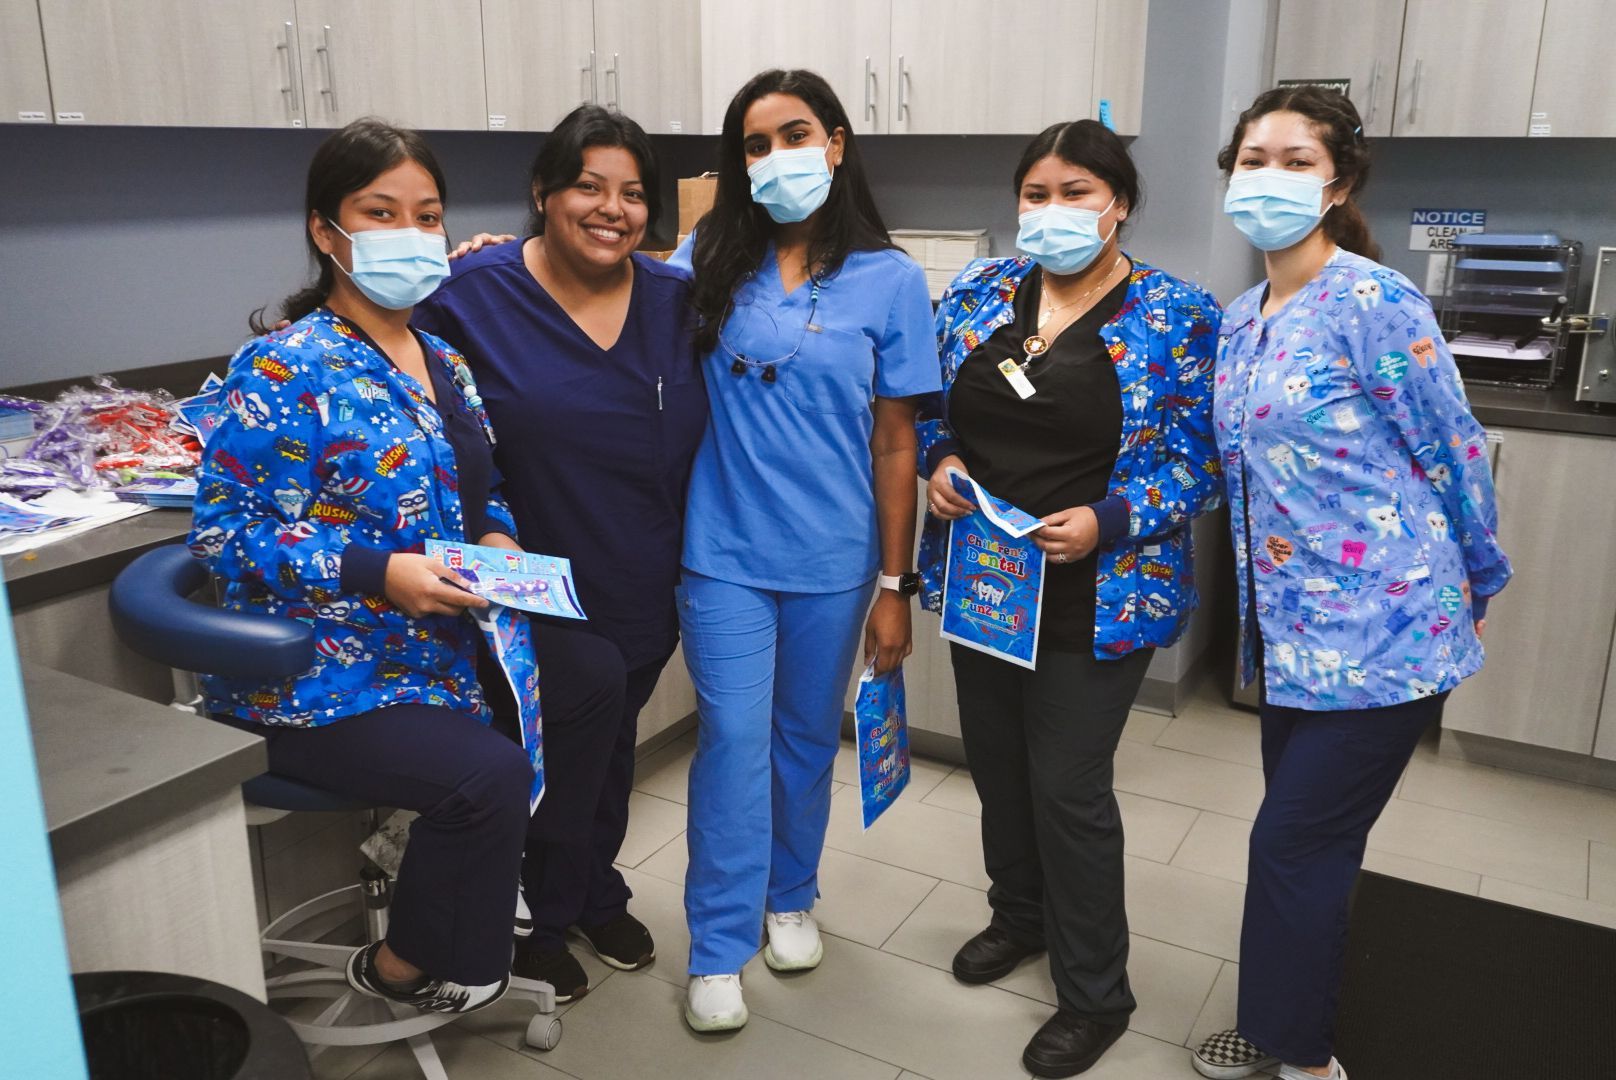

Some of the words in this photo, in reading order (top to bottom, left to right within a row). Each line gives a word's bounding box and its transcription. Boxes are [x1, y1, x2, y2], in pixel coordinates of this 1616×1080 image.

[1413, 211, 1484, 224] NOTICE
[1428, 238, 1455, 249] ARE
[375, 442, 409, 477] BRUSH!!
[967, 533, 1028, 560] Children's
[967, 546, 1026, 577] Dental
